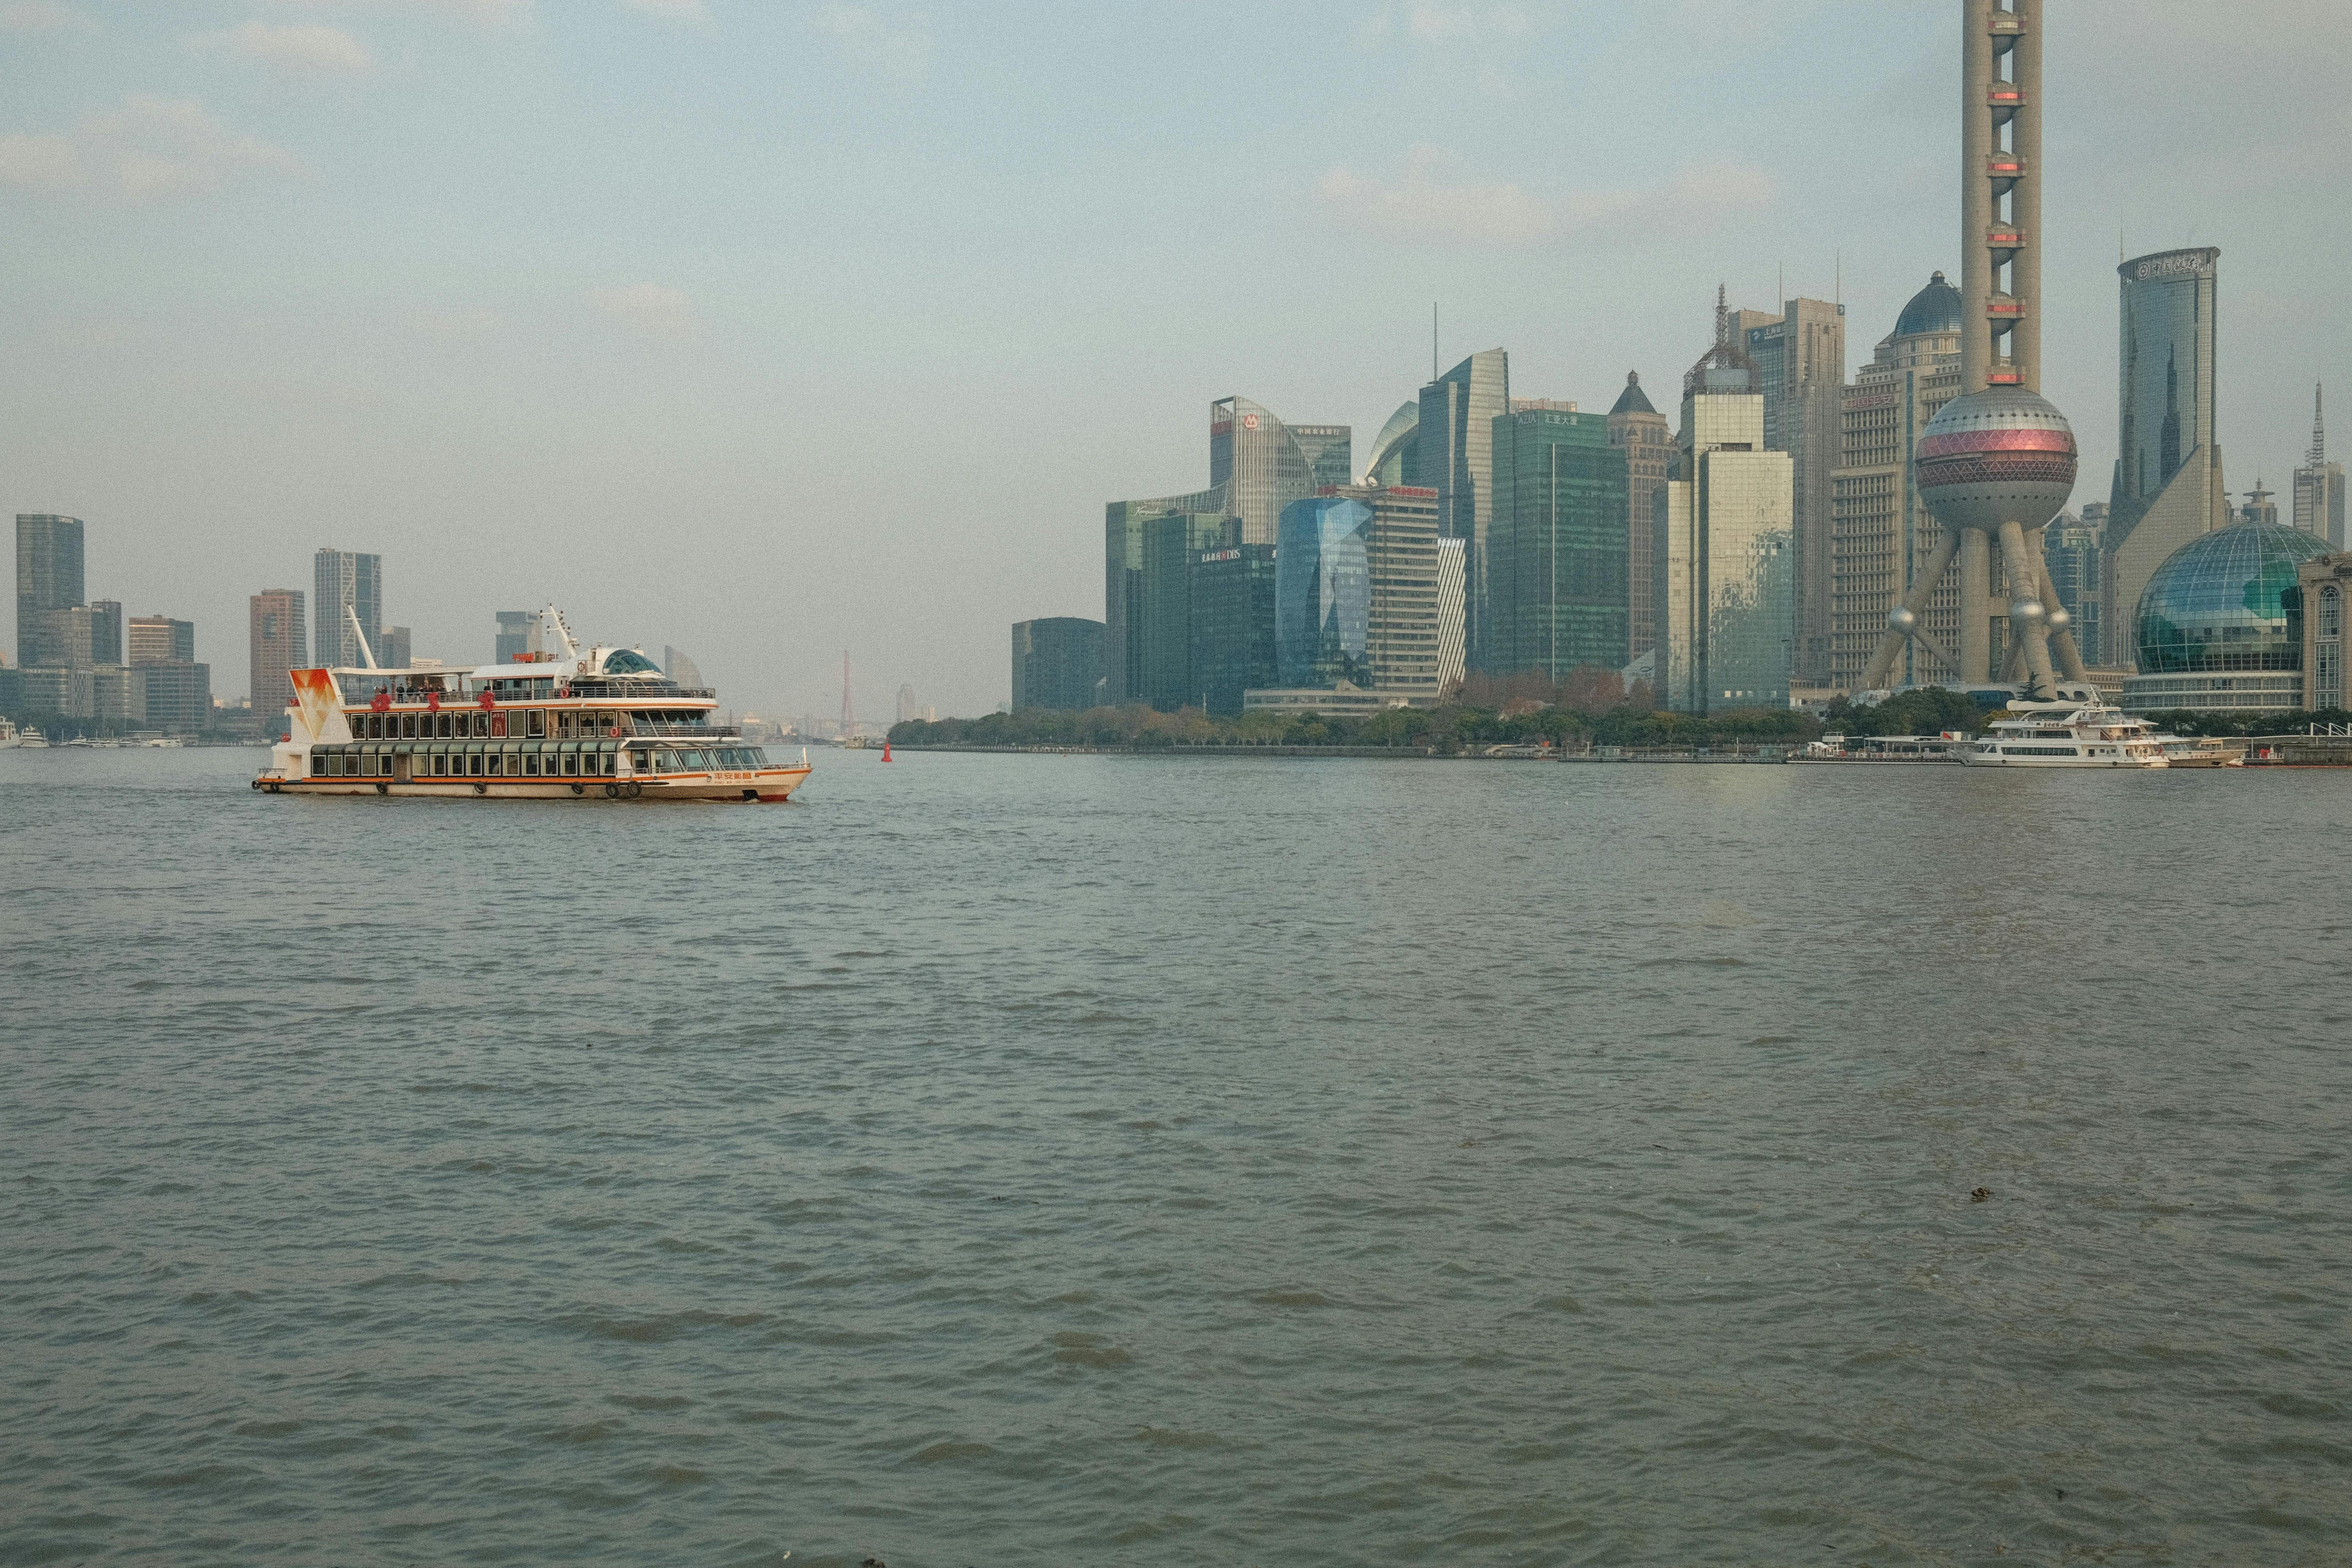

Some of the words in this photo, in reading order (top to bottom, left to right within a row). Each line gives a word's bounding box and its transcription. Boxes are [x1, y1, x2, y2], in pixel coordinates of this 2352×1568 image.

[2153, 256, 2200, 276] 中国银行
[1845, 394, 1892, 408] 中国平安
[1518, 414, 1536, 425] AZIA
[1545, 414, 1577, 425] 汇亚大厦
[1227, 549, 1240, 559] DBS
